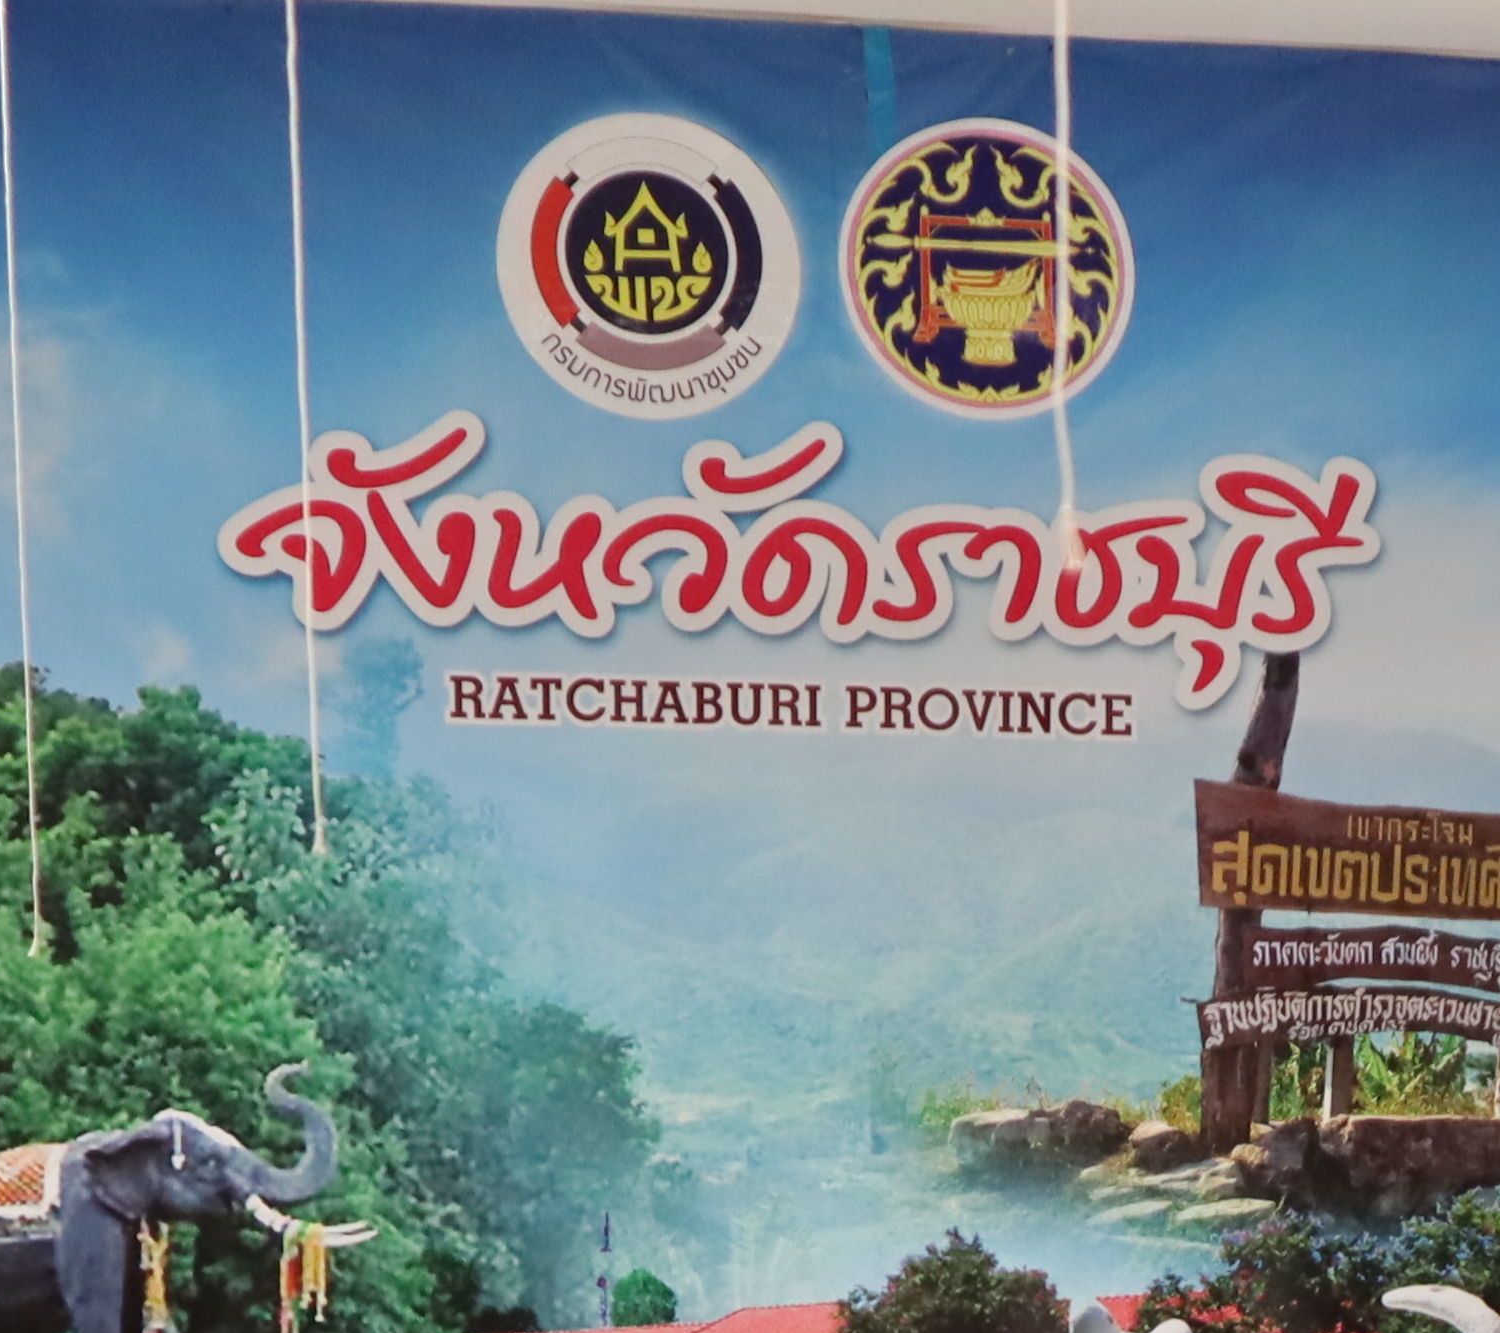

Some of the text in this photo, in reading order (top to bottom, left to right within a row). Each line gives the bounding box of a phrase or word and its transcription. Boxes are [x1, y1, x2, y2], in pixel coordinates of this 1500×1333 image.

[541, 332, 762, 403] กรมการพัฒนาชุมชน
[234, 426, 1368, 694] จังหวัดราชบุรี
[448, 674, 1133, 737] RATCHABURI PROVINCE
[1346, 811, 1474, 846] เขากระโจม
[1253, 932, 1373, 967] ภาคตะวันตก
[1381, 928, 1439, 966] สวนผึ้ง
